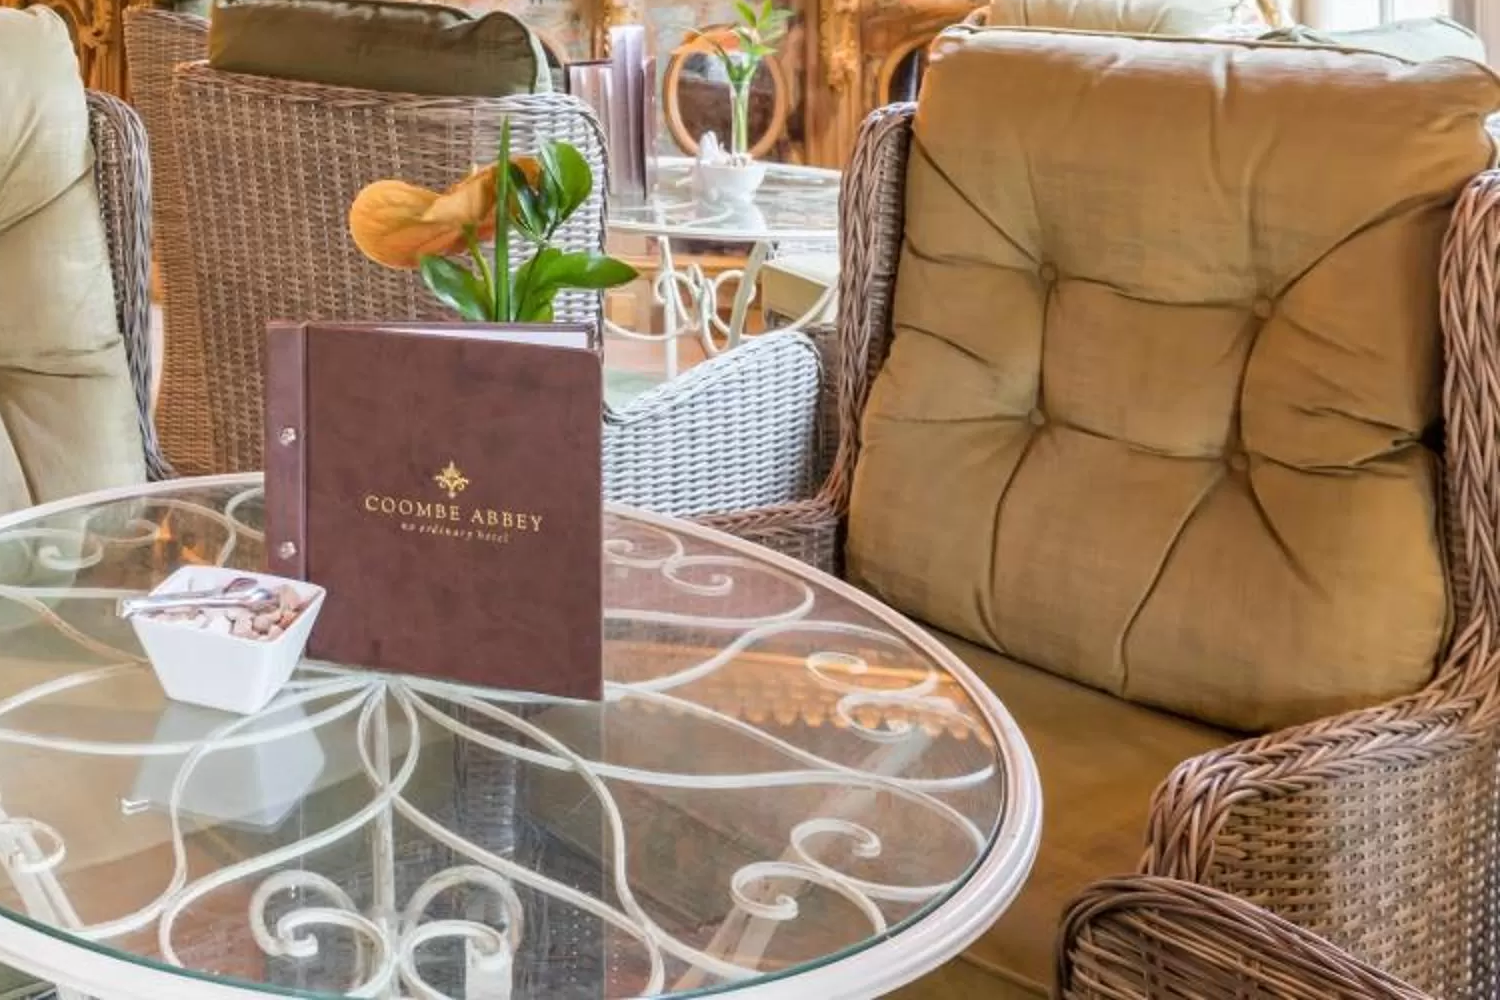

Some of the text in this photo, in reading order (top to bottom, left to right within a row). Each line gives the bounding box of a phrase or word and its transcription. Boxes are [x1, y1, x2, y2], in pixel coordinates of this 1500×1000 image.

[364, 495, 543, 532] COOMBE ABBEY
[419, 523, 473, 541] ordinary
[476, 529, 509, 543] hotel
